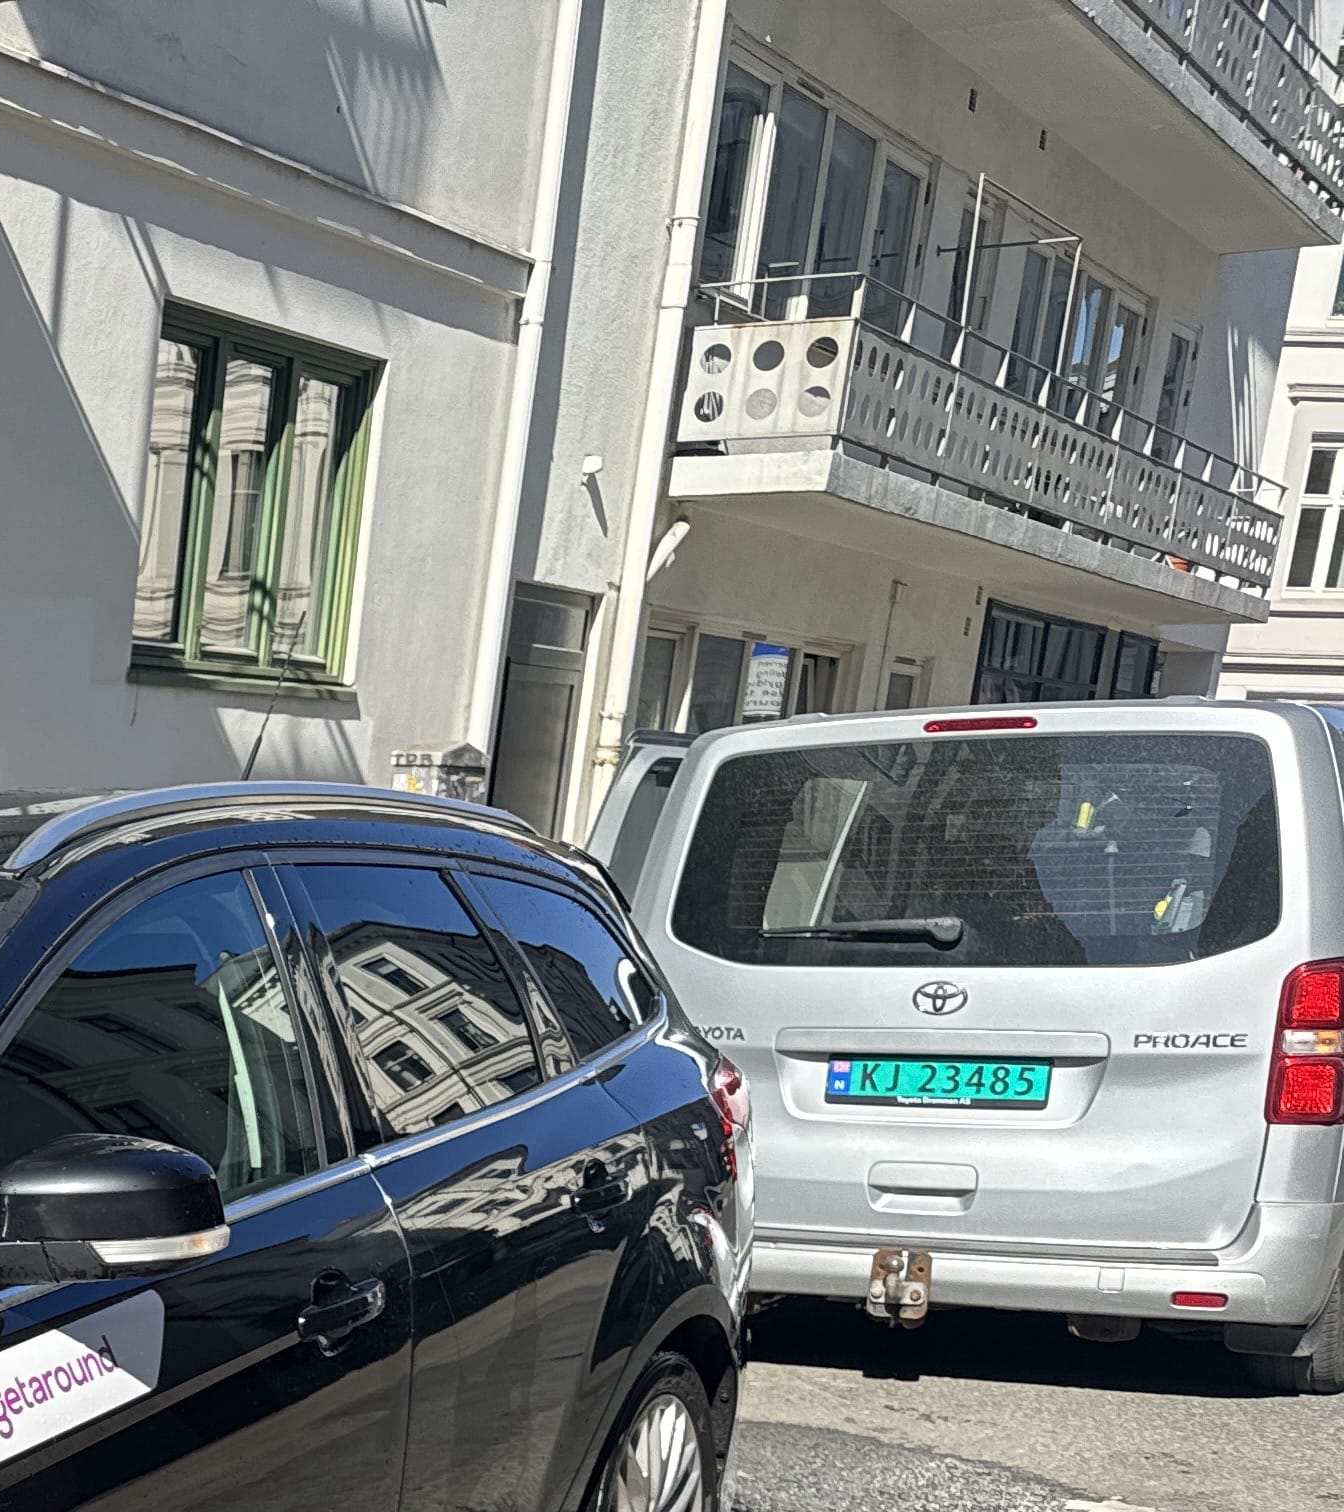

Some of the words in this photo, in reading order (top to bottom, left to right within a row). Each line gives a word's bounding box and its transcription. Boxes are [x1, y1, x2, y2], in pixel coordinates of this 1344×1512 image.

[695, 1026, 745, 1041] YOTA
[1133, 1033, 1249, 1049] PROACE
[860, 1063, 901, 1093] KJ
[917, 1064, 1036, 1096] 23485
